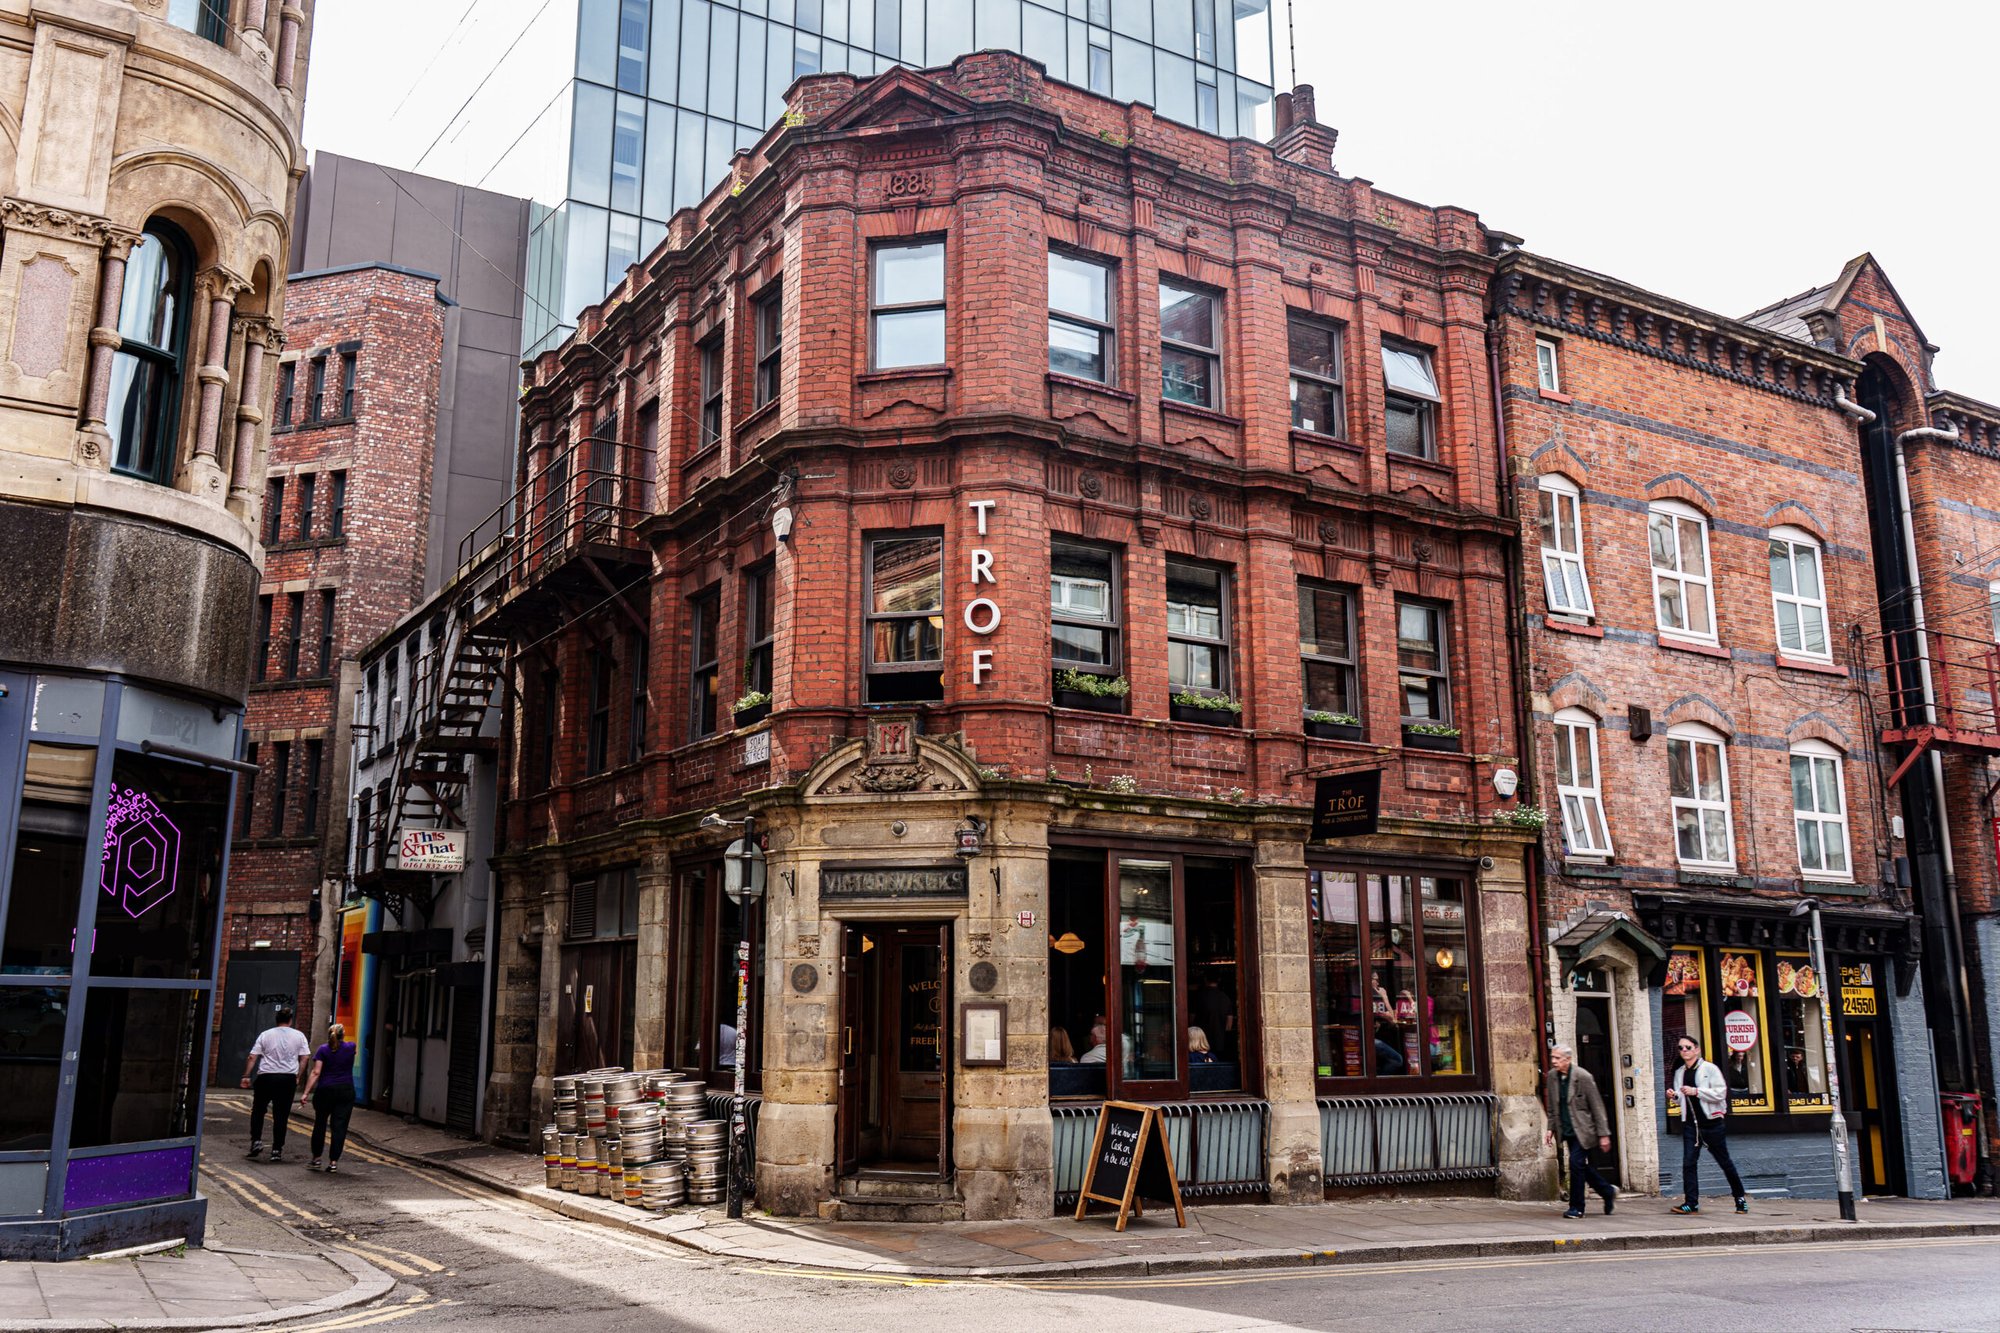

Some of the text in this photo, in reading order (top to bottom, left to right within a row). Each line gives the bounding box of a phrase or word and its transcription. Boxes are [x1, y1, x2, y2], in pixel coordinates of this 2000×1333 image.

[964, 499, 1001, 686] TROF
[750, 734, 765, 749] SOAP
[745, 746, 768, 764] STREET
[1328, 796, 1365, 811] TROF
[408, 831, 446, 844] This
[401, 838, 457, 858] & That
[1842, 977, 1861, 986] LAB
[1842, 997, 1875, 1013] 24550
[1730, 1035, 1751, 1044] GRILL
[1750, 1098, 1765, 1106] LAB
[1806, 1098, 1821, 1106] LAB
[1123, 1145, 1130, 1154] on
